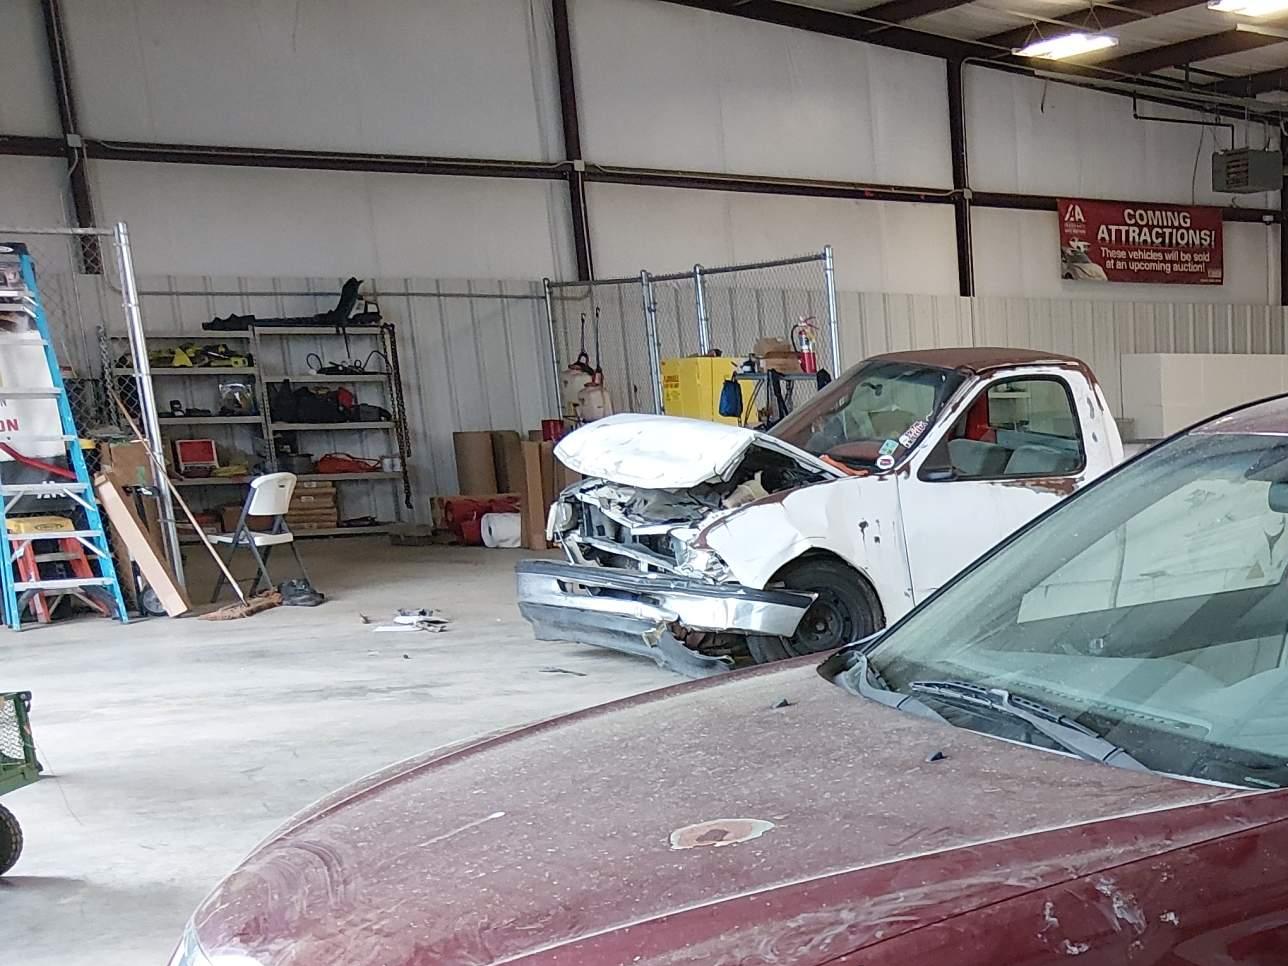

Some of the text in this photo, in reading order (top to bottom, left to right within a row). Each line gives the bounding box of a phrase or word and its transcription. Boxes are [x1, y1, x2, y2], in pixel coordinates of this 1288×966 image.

[1124, 208, 1191, 228] COMING
[1097, 224, 1215, 248] ATTRACTIONS!
[1100, 247, 1210, 262] These vehicles will be sold
[1105, 259, 1206, 274] at an upcoming auction!
